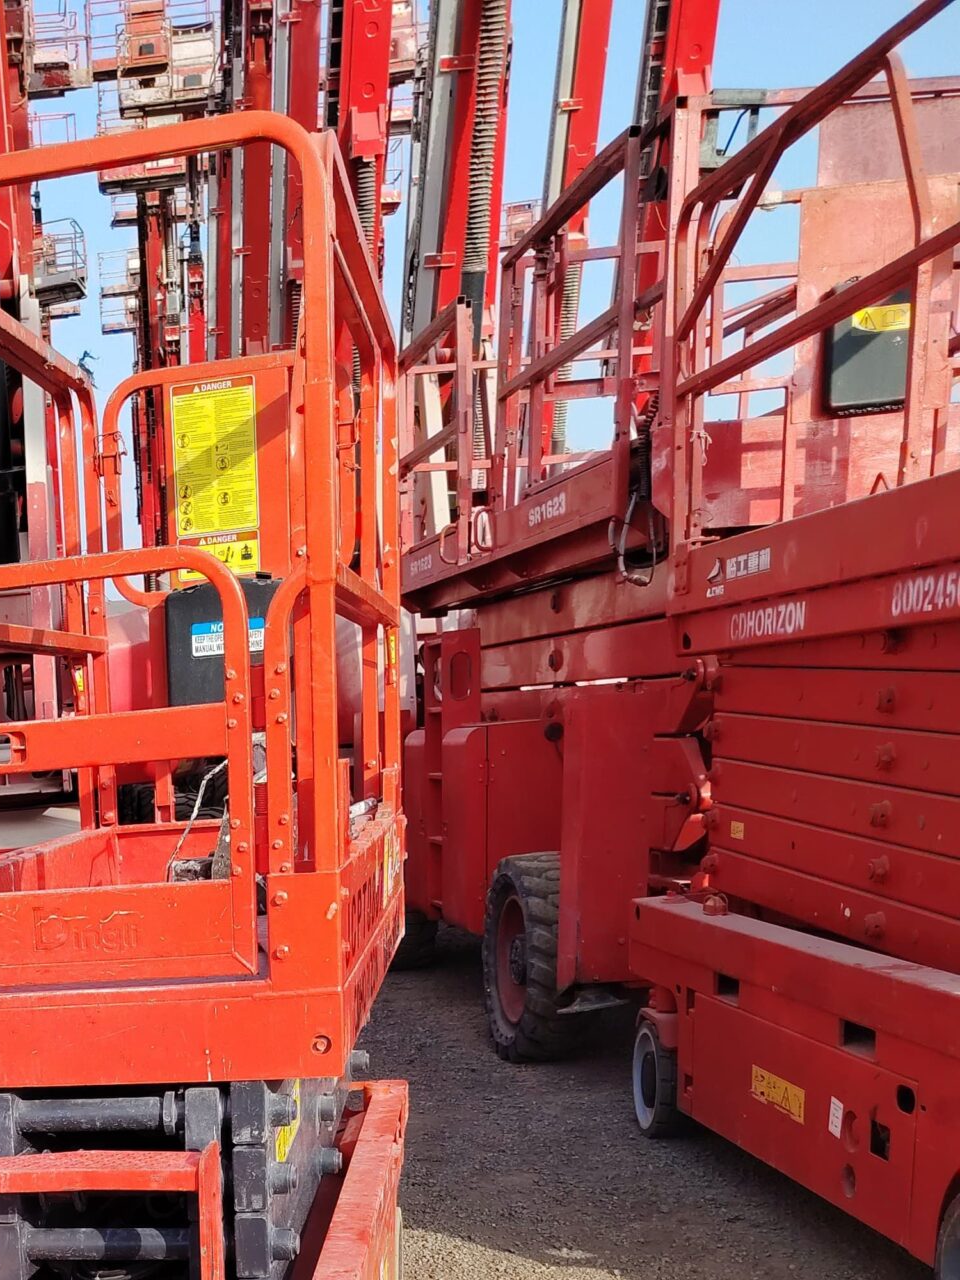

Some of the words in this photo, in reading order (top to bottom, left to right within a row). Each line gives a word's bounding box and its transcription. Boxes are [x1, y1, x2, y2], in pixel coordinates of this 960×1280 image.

[201, 380, 232, 392] DANGER
[528, 492, 566, 527] SR1623
[207, 534, 237, 545] DANGER
[892, 571, 960, 617] 800245
[730, 601, 806, 640] CDHORIZON
[194, 643, 216, 654] MANUAL
